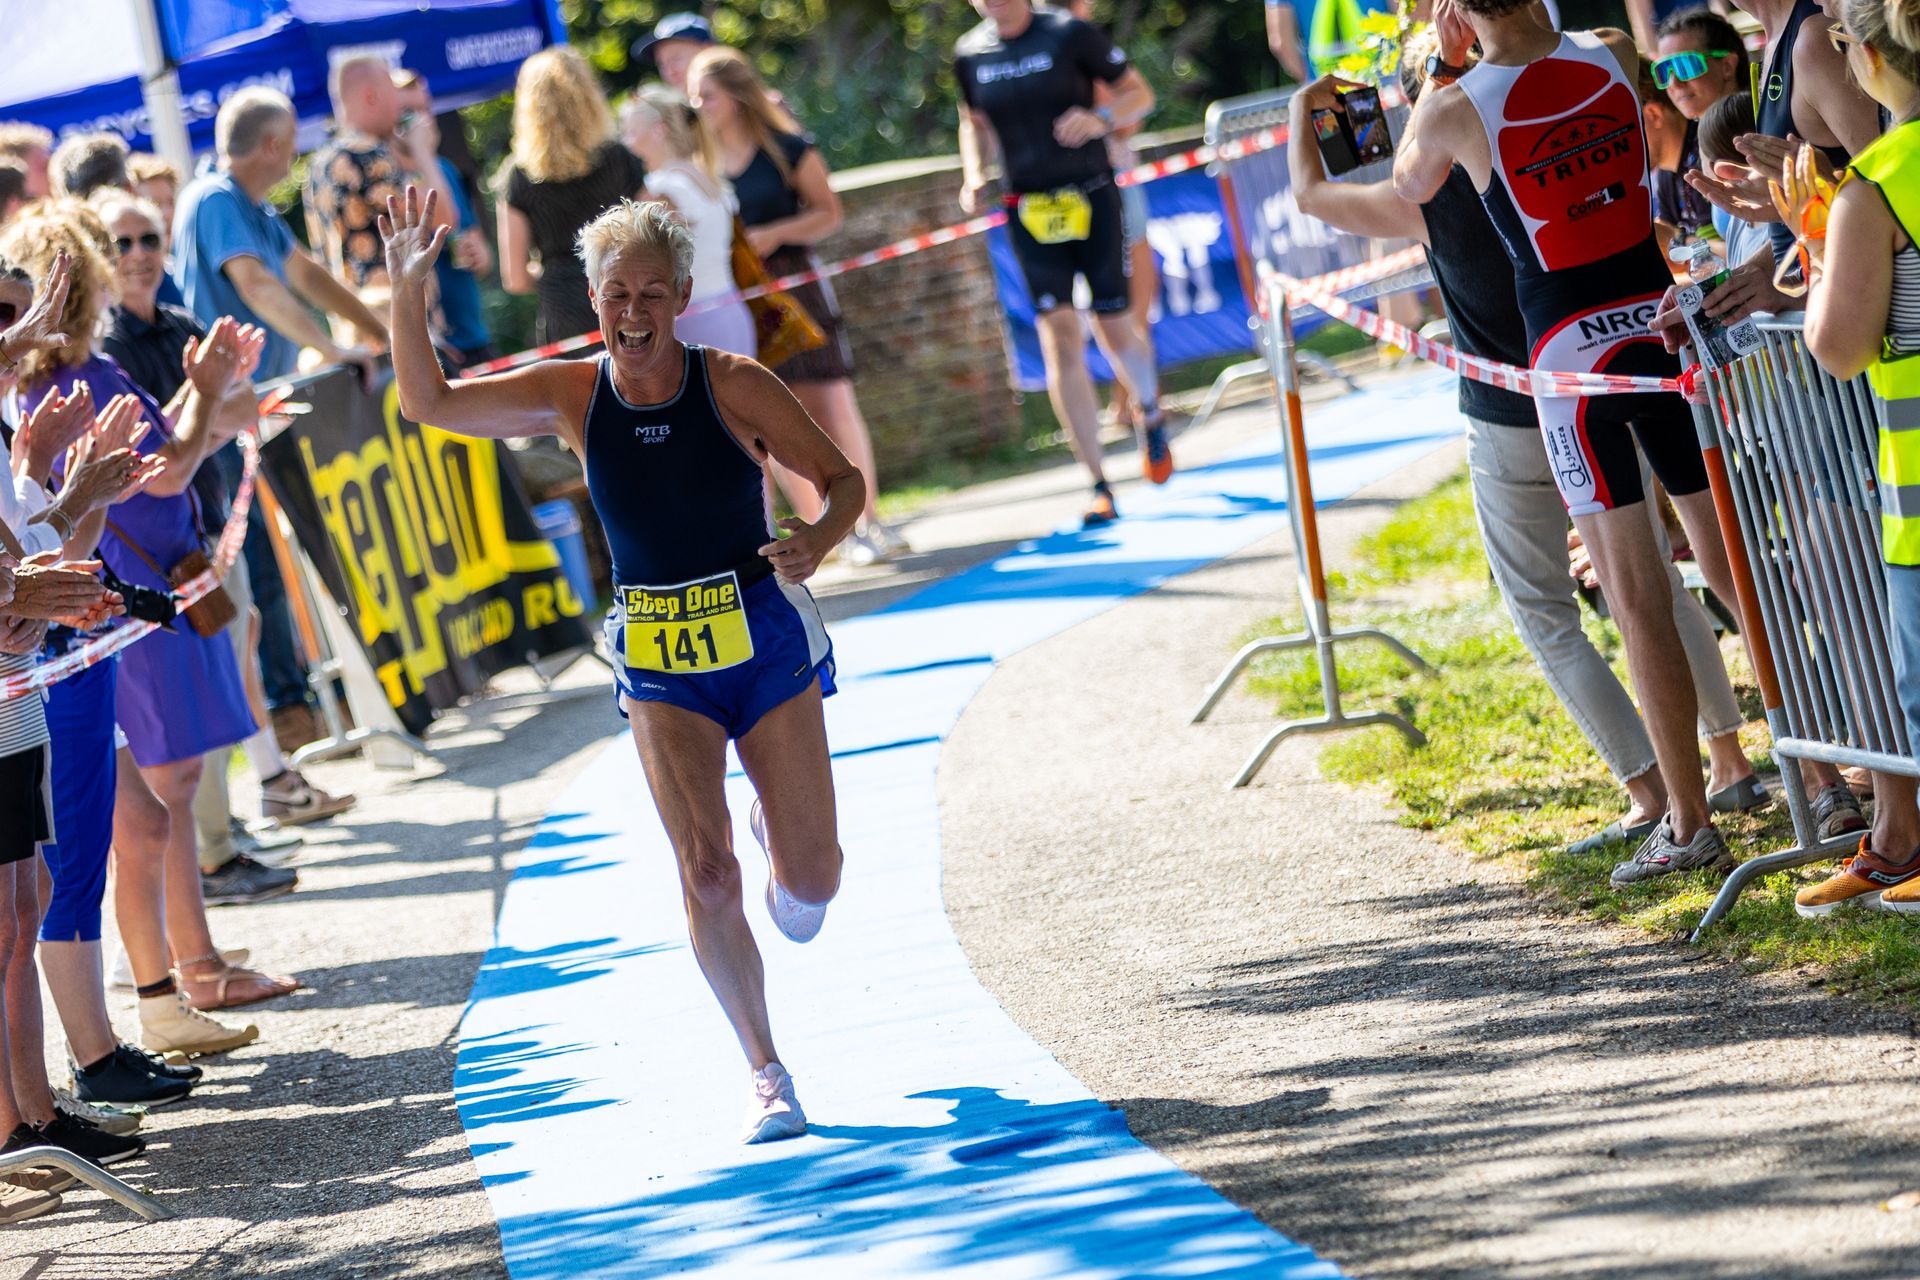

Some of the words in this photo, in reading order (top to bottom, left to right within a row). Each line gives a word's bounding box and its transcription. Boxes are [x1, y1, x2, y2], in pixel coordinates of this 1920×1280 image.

[1532, 137, 1630, 187] TRION
[1578, 304, 1657, 340] NRG
[1577, 341, 1599, 352] maakt
[1599, 333, 1631, 344] duurzame
[635, 425, 671, 436] MTB
[642, 436, 666, 444] SPORT
[1557, 425, 1587, 488] dijkstra
[627, 590, 680, 620] Step
[686, 583, 735, 613] One
[687, 611, 706, 620] TRAIL
[706, 608, 720, 616] AND
[720, 604, 734, 613] RUN
[653, 623, 719, 670] 141
[641, 682, 662, 691] CRAFT
